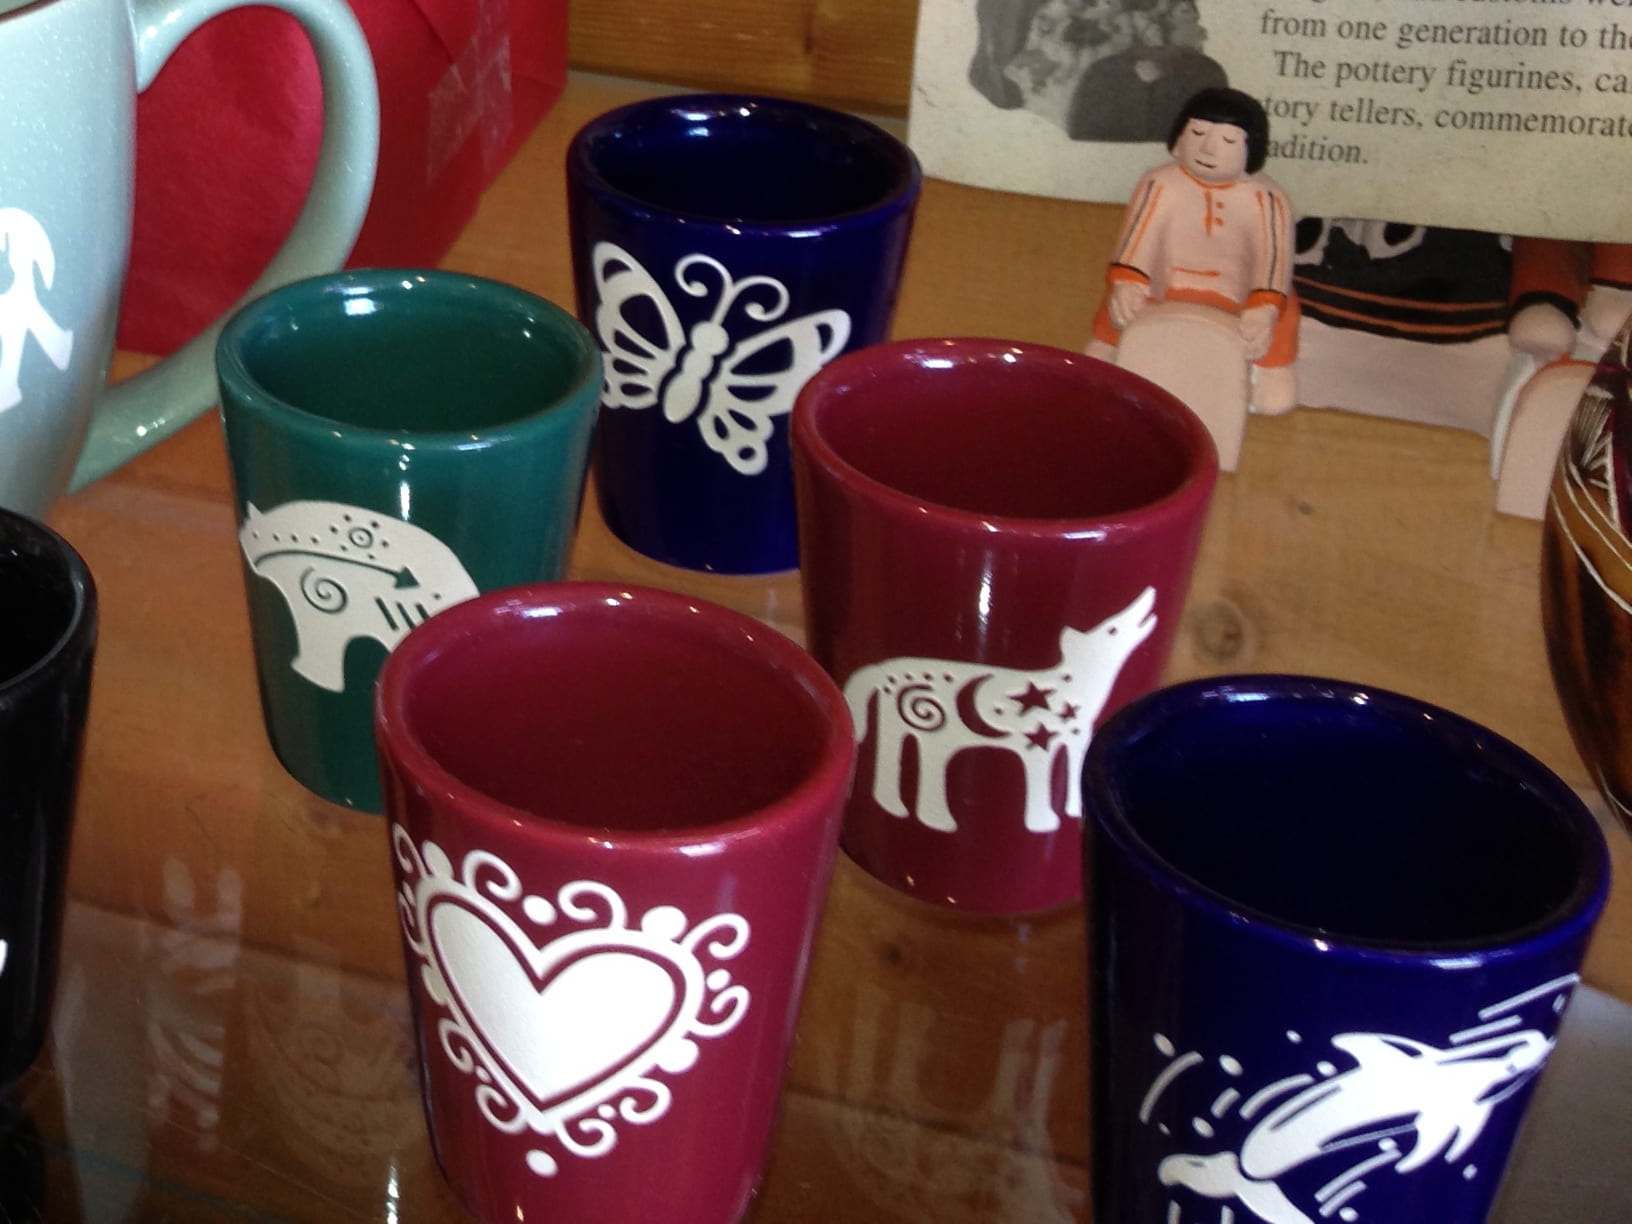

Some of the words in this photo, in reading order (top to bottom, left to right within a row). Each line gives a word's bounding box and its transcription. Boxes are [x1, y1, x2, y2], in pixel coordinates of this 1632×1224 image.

[1261, 8, 1327, 38] from
[1336, 20, 1388, 41] one
[1395, 19, 1548, 50] generation
[1558, 25, 1588, 48] to
[1273, 49, 1326, 79] The
[1335, 61, 1437, 93] pottery
[1446, 59, 1582, 95] figurines,
[1594, 73, 1632, 94] ca
[1264, 97, 1319, 127] tory
[1329, 97, 1423, 128] tellers,
[1268, 134, 1368, 164] adition.
